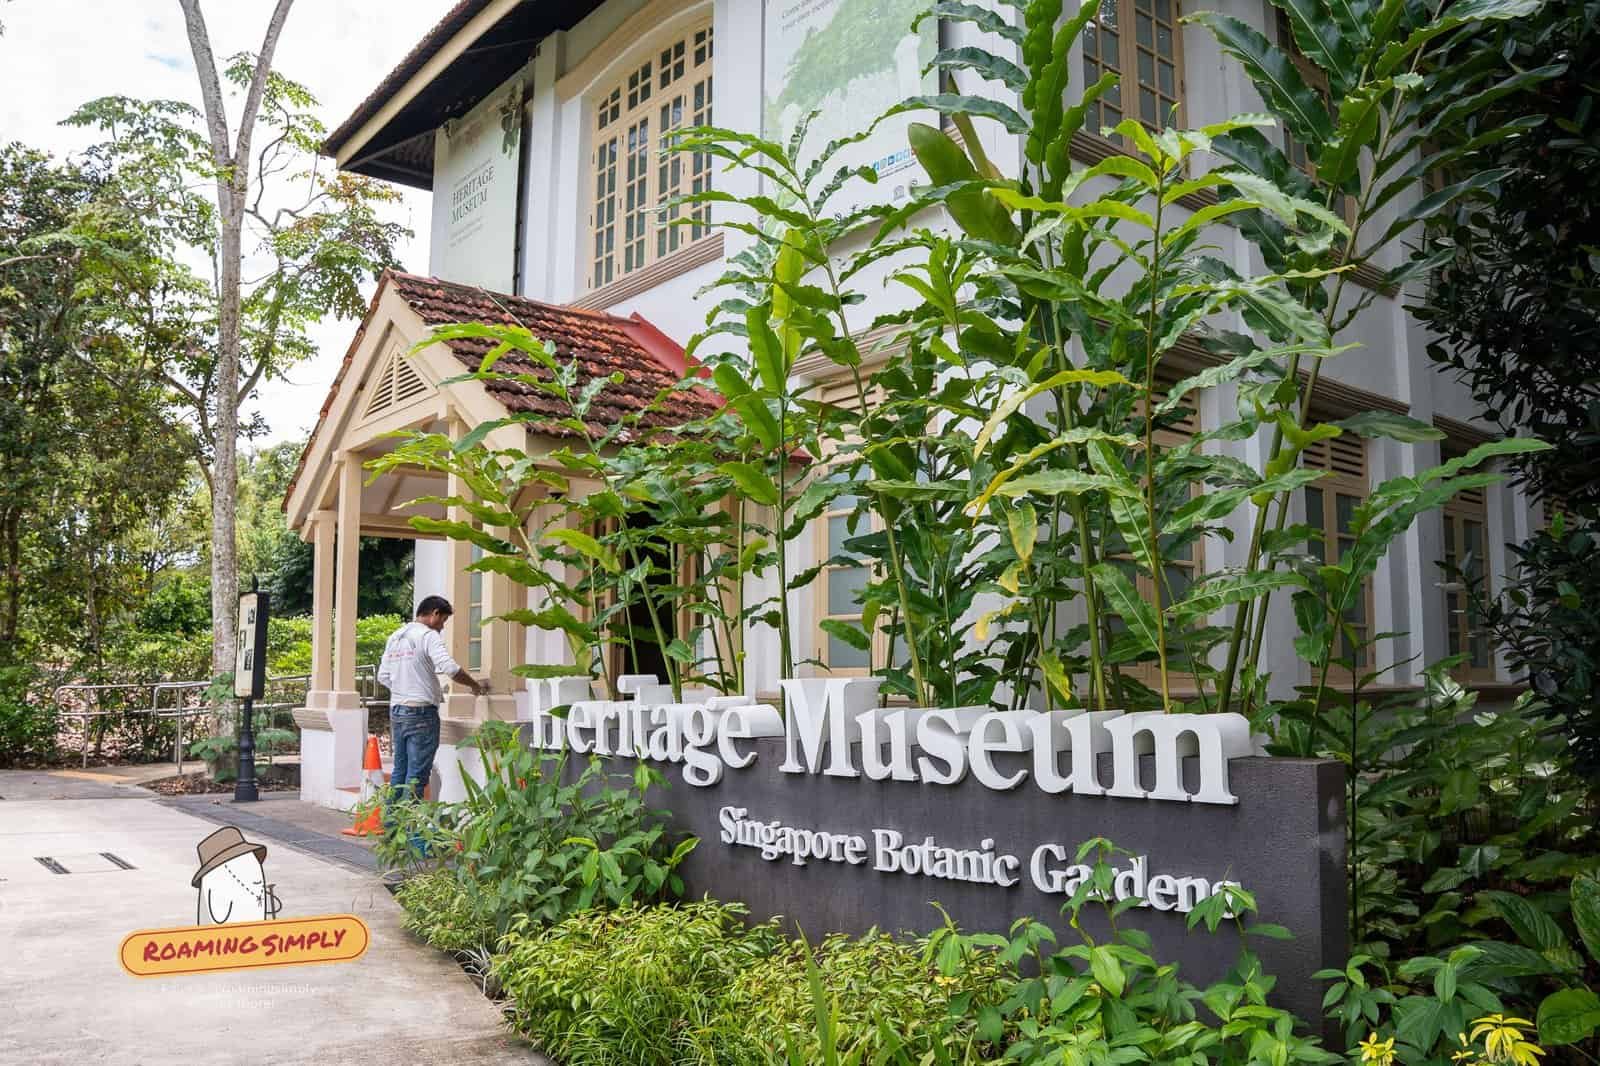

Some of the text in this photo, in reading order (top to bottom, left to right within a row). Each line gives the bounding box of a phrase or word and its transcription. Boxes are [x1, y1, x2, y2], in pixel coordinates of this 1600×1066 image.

[451, 187, 488, 224] MUSEUM
[452, 165, 495, 208] HERITAGE
[527, 674, 1250, 803] Heritage Museum
[719, 806, 868, 866] Singapore
[872, 829, 1020, 887] Botanic
